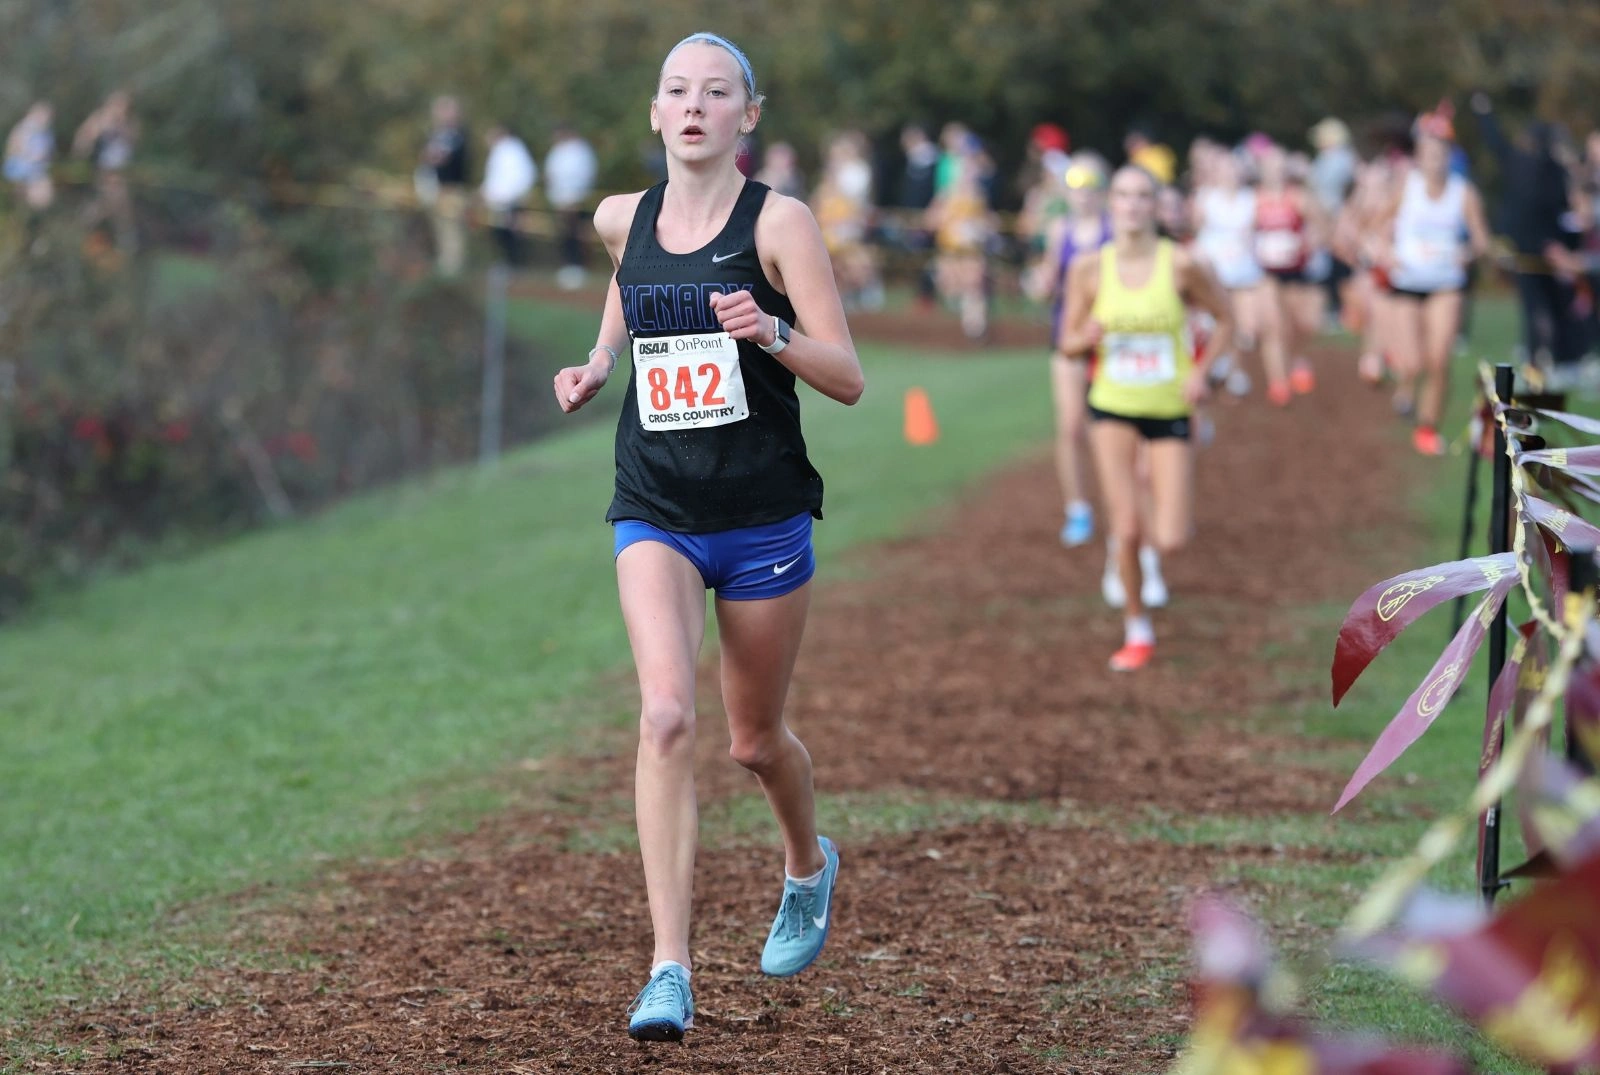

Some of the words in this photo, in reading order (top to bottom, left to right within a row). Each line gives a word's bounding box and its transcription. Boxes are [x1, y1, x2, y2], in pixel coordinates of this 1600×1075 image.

[620, 283, 753, 331] MCNAR
[639, 342, 669, 354] OSAA
[675, 337, 723, 351] OnPoint
[648, 362, 726, 411] 842
[648, 412, 680, 423] CROSS
[683, 406, 735, 421] COUNTRY
